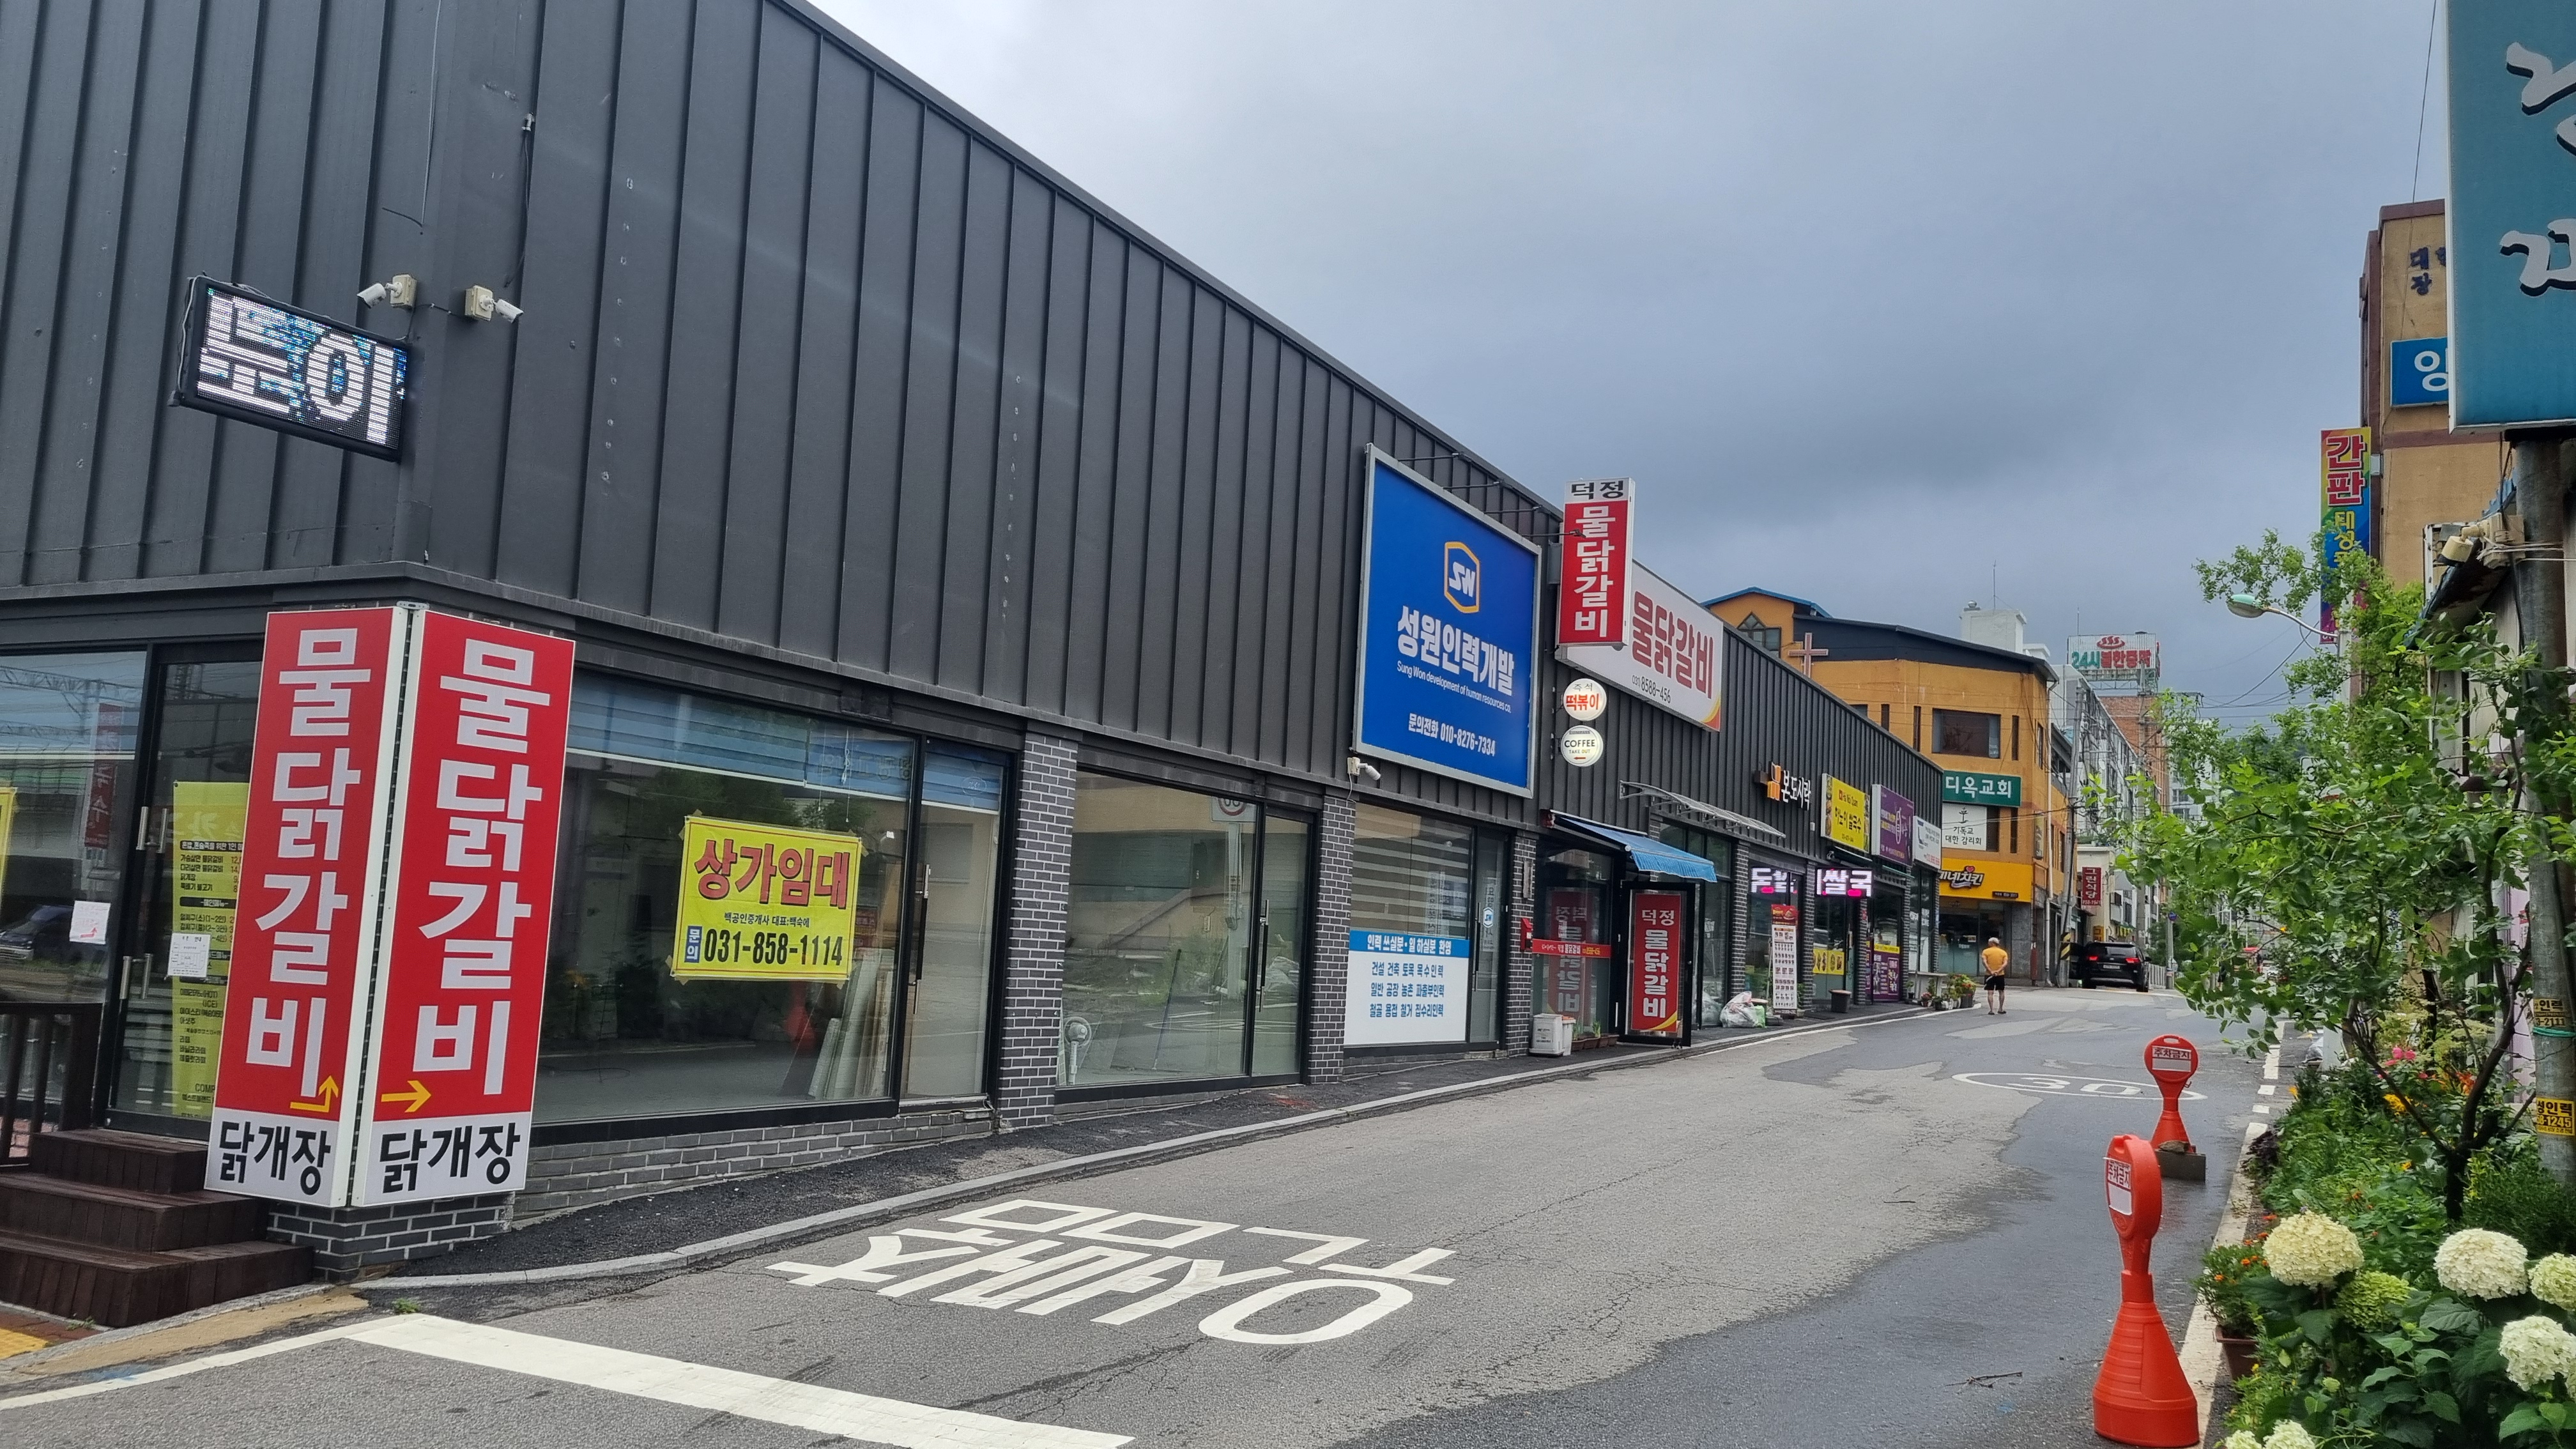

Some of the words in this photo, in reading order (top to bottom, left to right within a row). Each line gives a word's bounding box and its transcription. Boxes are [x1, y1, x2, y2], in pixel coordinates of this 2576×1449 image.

[2327, 434, 2365, 506] 간판
[1570, 480, 1624, 500] 덕정
[1574, 506, 1616, 638] 물닭갈비
[1398, 606, 1514, 696] 성원인력개발
[1632, 591, 1713, 699] 물닭갈비
[1397, 661, 1412, 678] Sung
[1413, 666, 1425, 680] Won
[1427, 671, 1459, 693] development
[1460, 686, 1466, 695] of
[1466, 686, 1482, 701] human
[1482, 694, 1505, 711] resources
[1566, 693, 1599, 710] 떡볶이
[1572, 683, 1593, 691] 즉석
[1408, 712, 1438, 739] 문의전화
[1440, 723, 1496, 756] 010-8276-7334
[1565, 739, 1595, 747] COFFEE
[1781, 770, 1811, 811] 본도시락
[1945, 835, 1958, 844] 대한
[1961, 836, 1981, 845] 감리회
[1953, 826, 1974, 836] 기독교
[246, 629, 371, 1098] 물닭갈비
[413, 638, 550, 1096] 물닭갈비
[694, 839, 850, 909] 상가임대
[724, 912, 769, 926] 백공인중개사
[1642, 909, 1675, 926] 덕정
[687, 928, 700, 960] 문의
[704, 928, 843, 965] 031-858-1114
[1367, 934, 1381, 950] 인력
[1417, 938, 1436, 954] 하실분
[1439, 940, 1452, 955] 환영
[1372, 962, 1384, 976] 건설
[1387, 962, 1400, 976] 건축
[1402, 963, 1414, 976] 토목
[1417, 964, 1443, 978] 목수인력
[1643, 929, 1669, 1018] 물닭갈비
[1370, 983, 1384, 997] 일반
[1386, 983, 1399, 997] 공장
[1402, 983, 1413, 997] 농촌
[1370, 1004, 1383, 1018] 철골
[1385, 1004, 1397, 1018] 용접
[1400, 1004, 1413, 1018] 철거
[1415, 1004, 1444, 1018] 집수리인력
[2154, 1048, 2189, 1059] 주차금지
[219, 1120, 330, 1196] 닭개장
[381, 1123, 520, 1195] 닭개장
[2108, 1163, 2130, 1188] 주차금지
